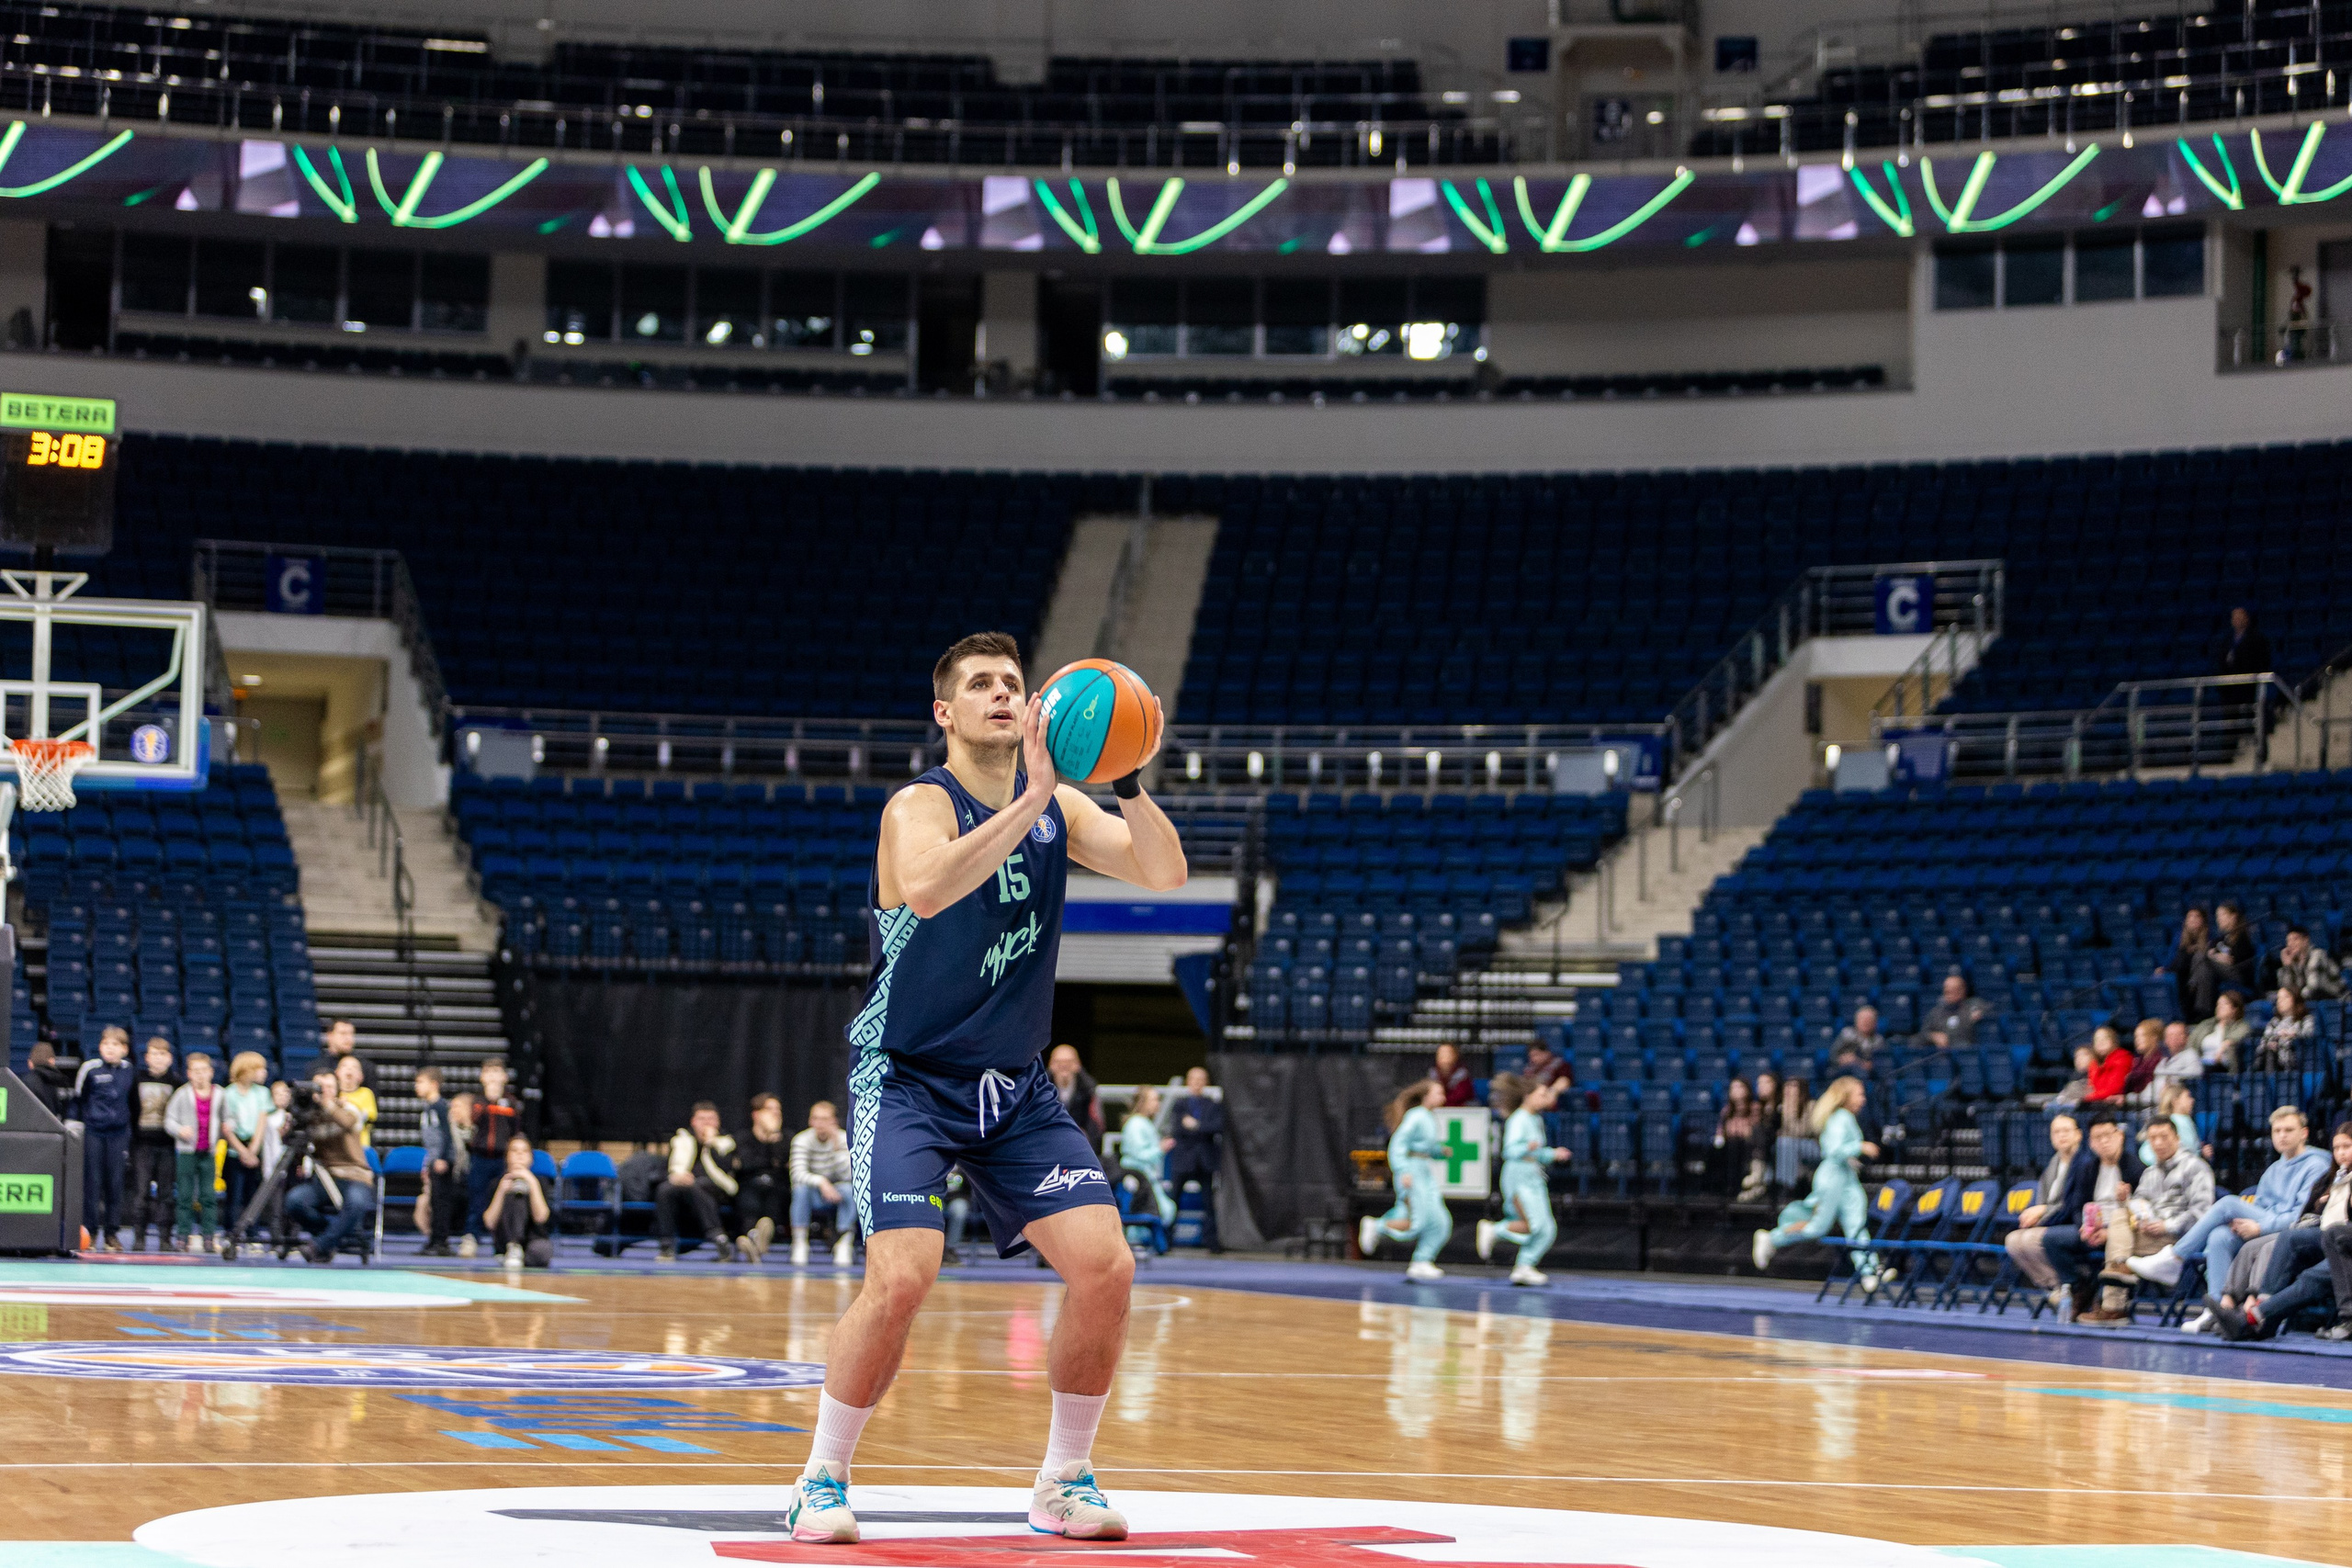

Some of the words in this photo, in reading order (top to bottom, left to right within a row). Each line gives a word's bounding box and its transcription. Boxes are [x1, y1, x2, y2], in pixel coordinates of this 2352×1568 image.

[28, 431, 106, 469] 3:08
[996, 853, 1031, 903] 15
[883, 1192, 925, 1204] Kempa
